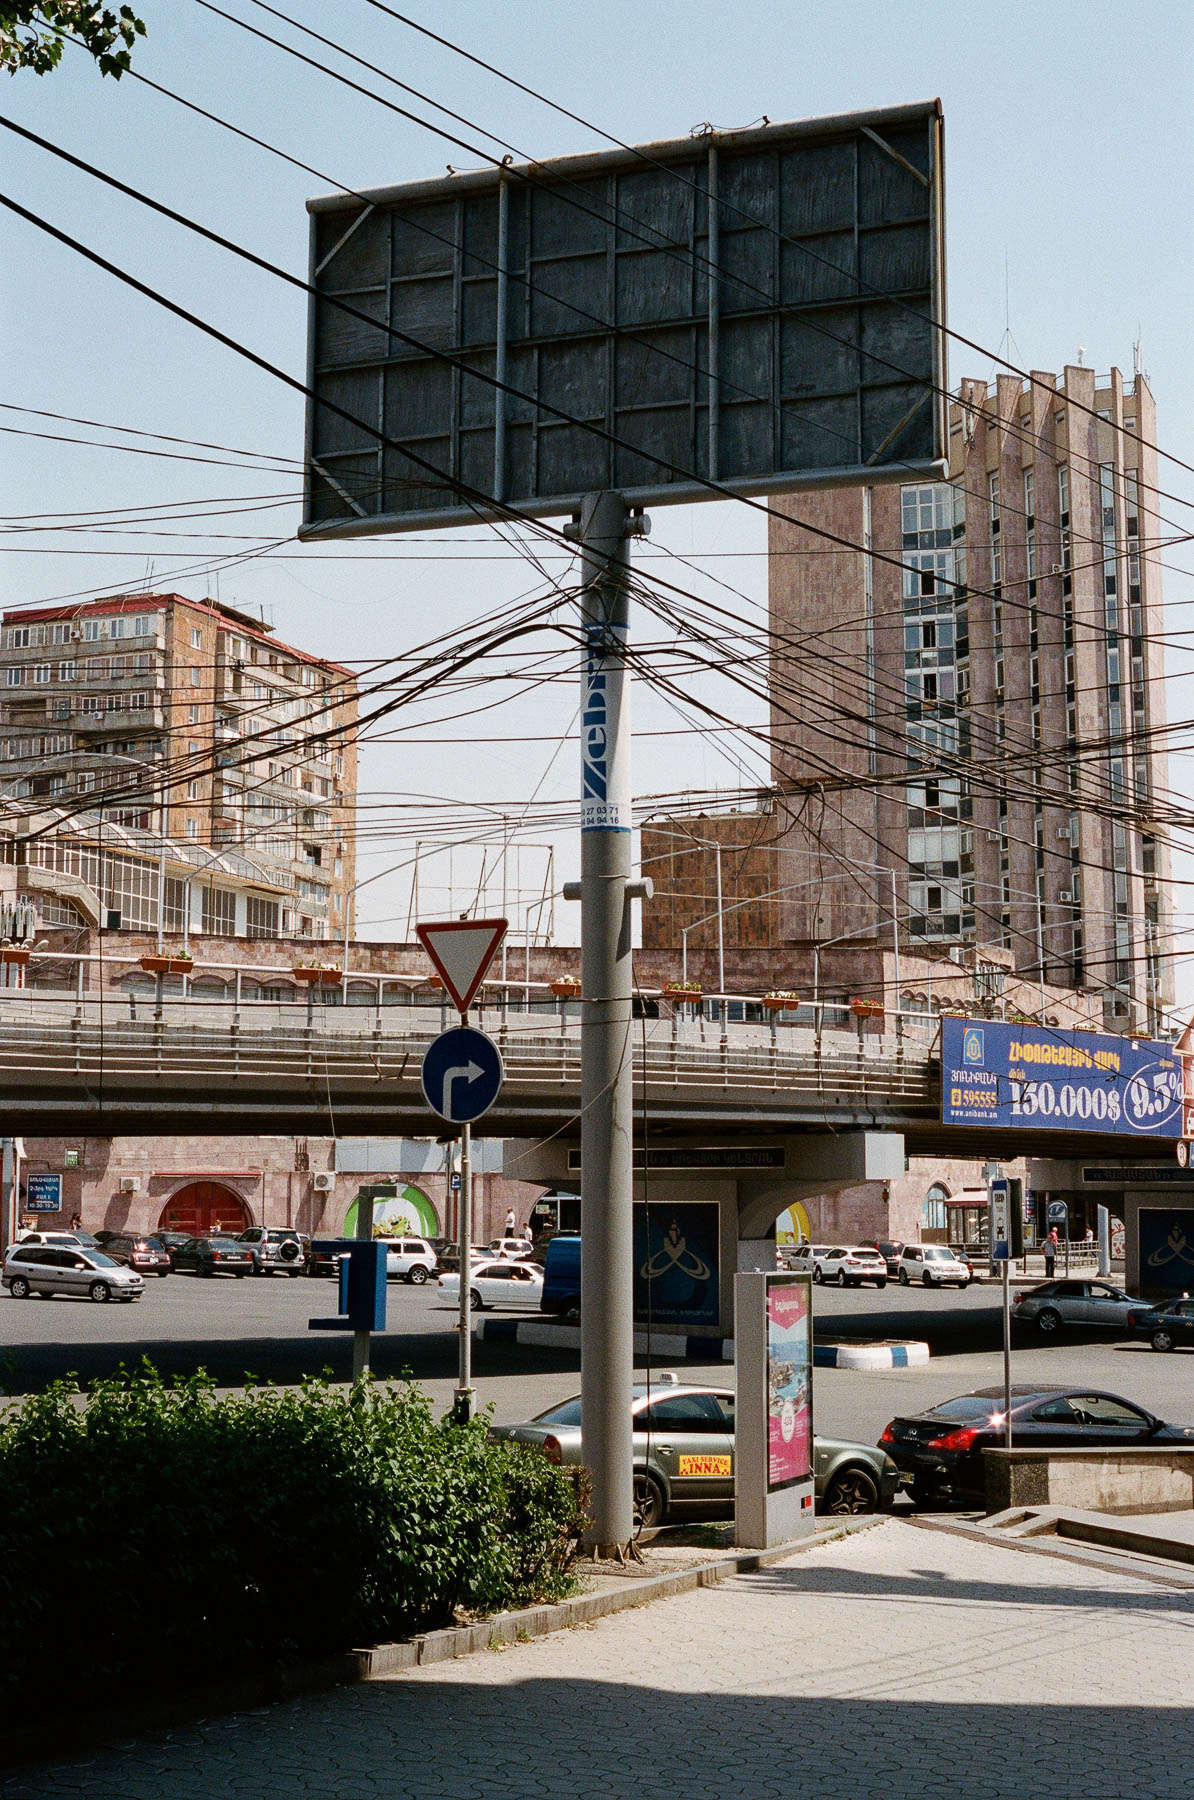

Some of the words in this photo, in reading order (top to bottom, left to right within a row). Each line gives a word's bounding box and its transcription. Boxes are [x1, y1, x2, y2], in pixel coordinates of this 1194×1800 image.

[587, 807, 594, 815] 27
[596, 806, 607, 815] 03
[609, 806, 619, 815] 71
[586, 817, 594, 825] 94
[596, 816, 608, 824] 94
[610, 816, 620, 824] 16
[1131, 1071, 1183, 1119] 9.5%
[1009, 1082, 1121, 1124] 150.000$
[950, 1109, 998, 1119] www.unibank.am
[452, 1174, 460, 1185] P
[682, 1456, 699, 1464] TAXI
[700, 1456, 729, 1465] SERVICE
[690, 1463, 721, 1473] INNA
